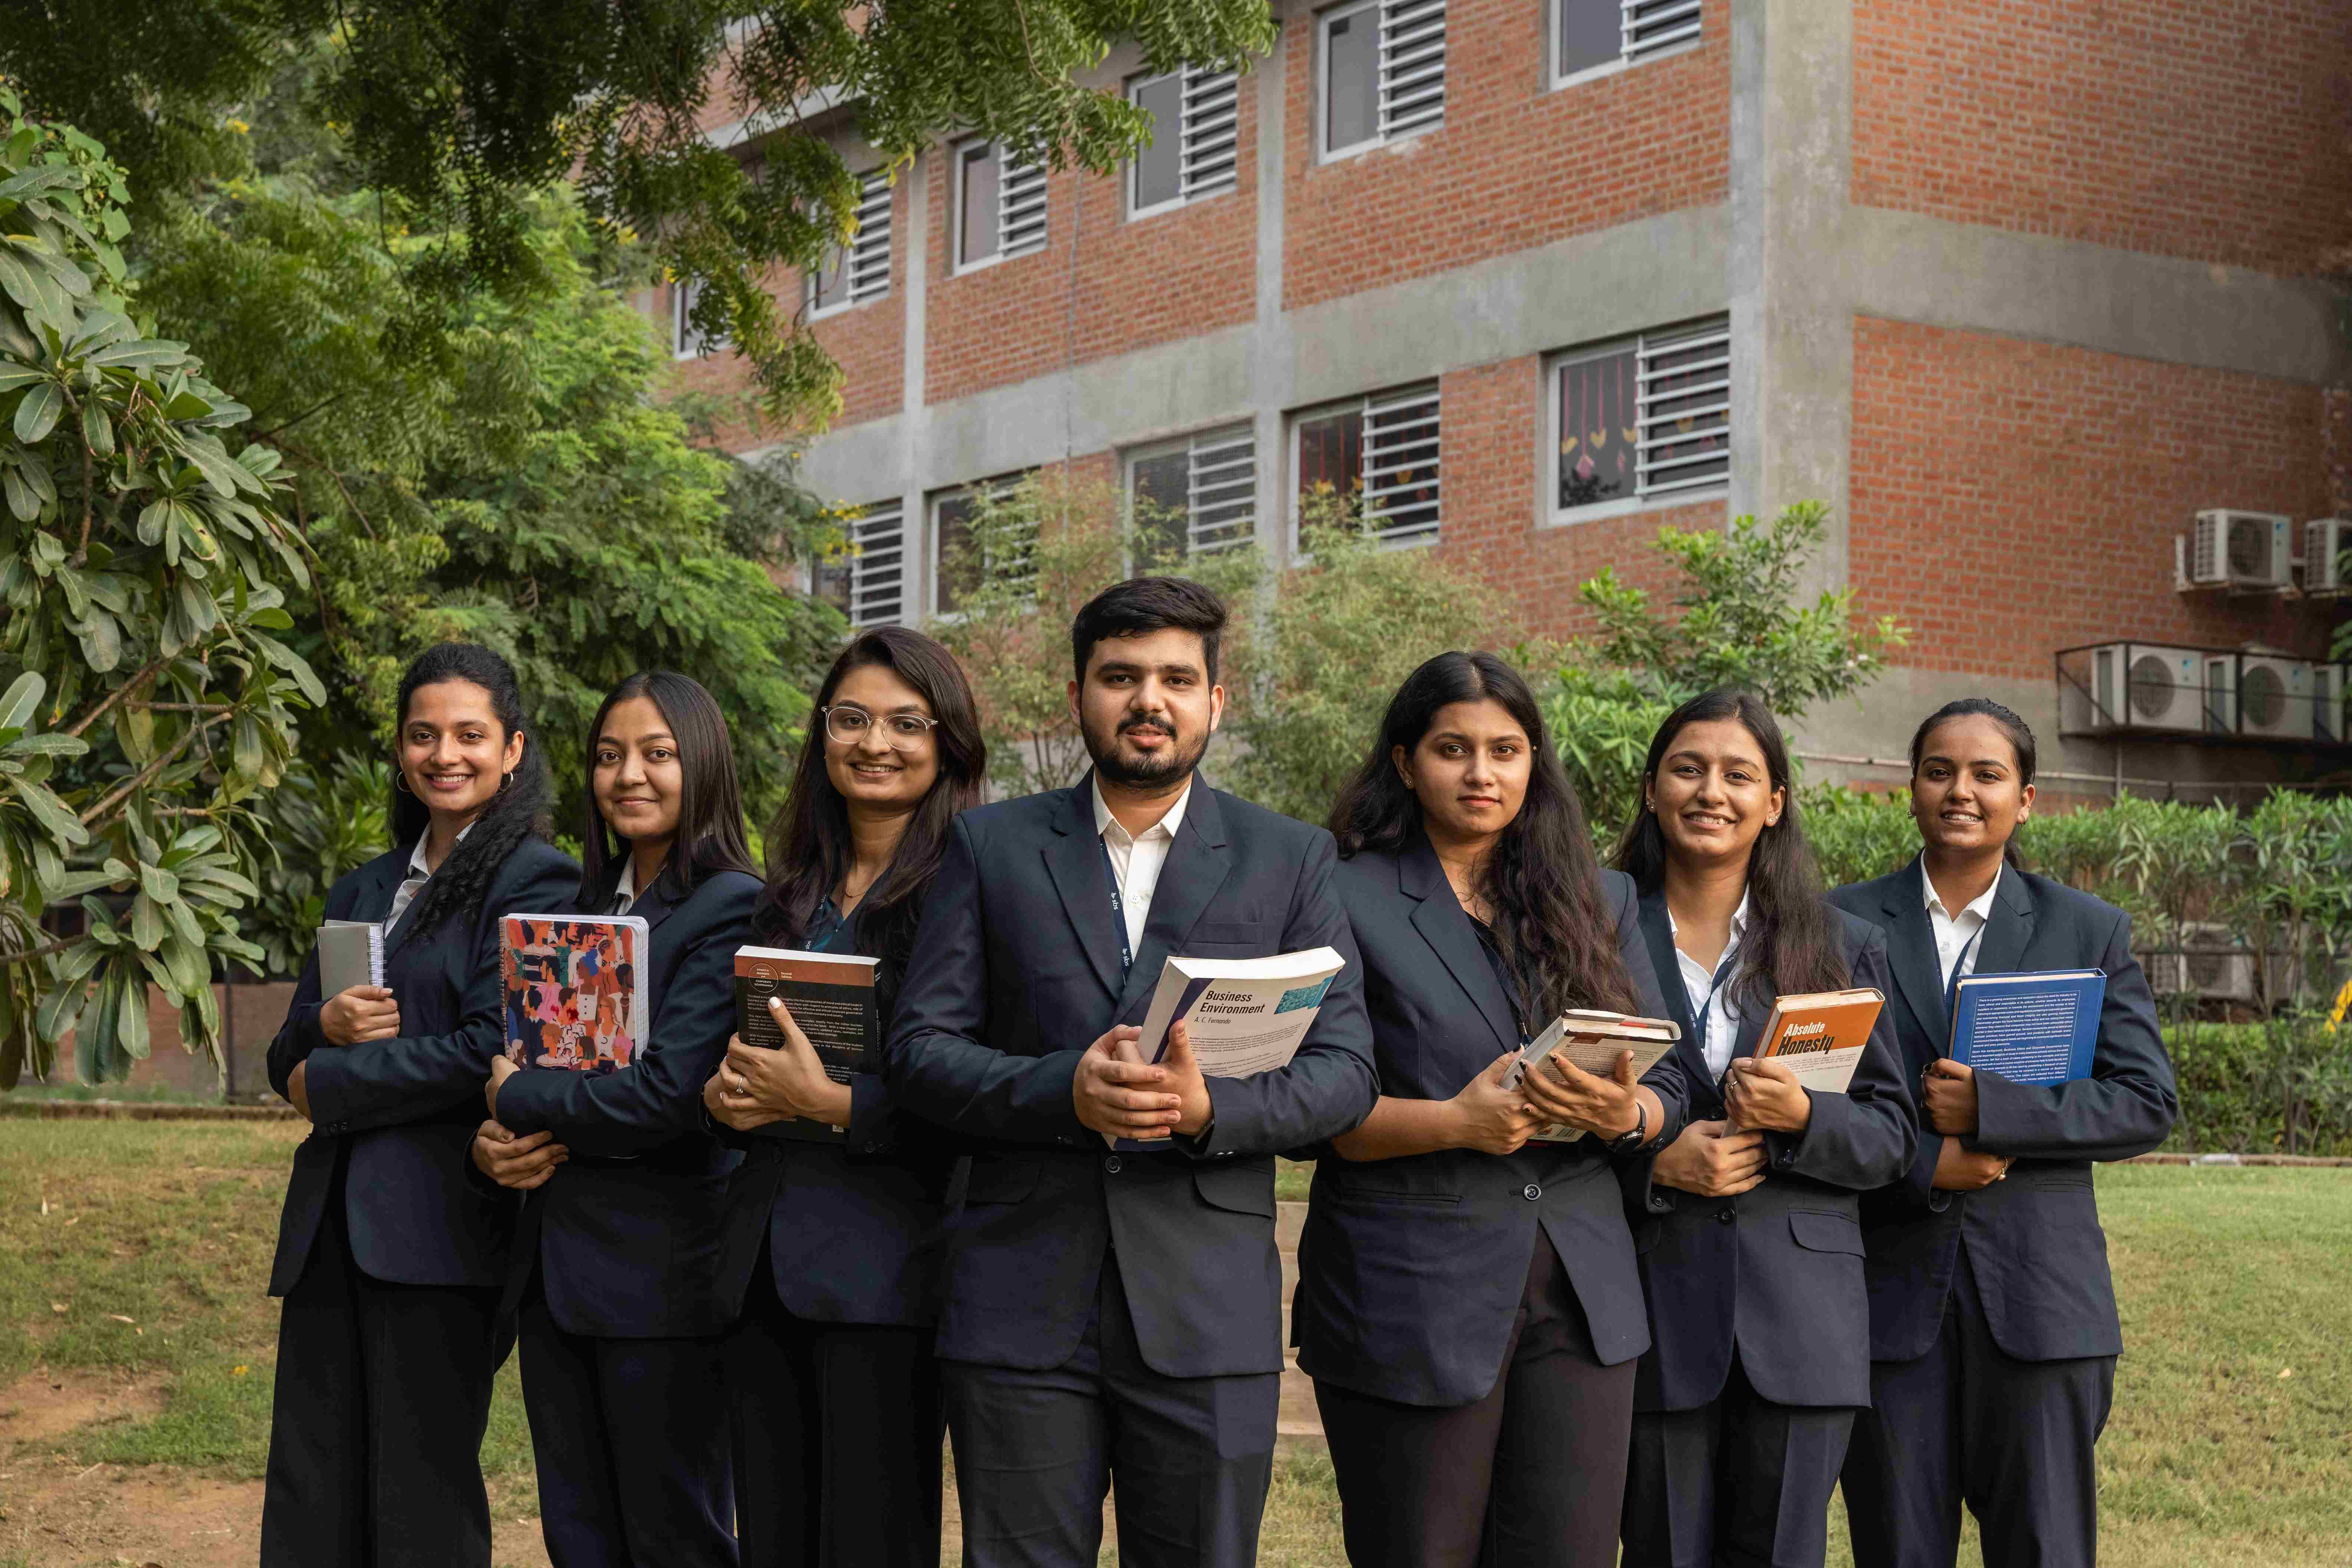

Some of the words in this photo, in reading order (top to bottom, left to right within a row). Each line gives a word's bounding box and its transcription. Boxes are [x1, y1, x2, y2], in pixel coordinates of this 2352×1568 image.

[1206, 991, 1252, 1002] Business
[1200, 1002, 1265, 1014] Environment
[1783, 1022, 1825, 1037] Absolute
[1775, 1034, 1835, 1056] Honesty
